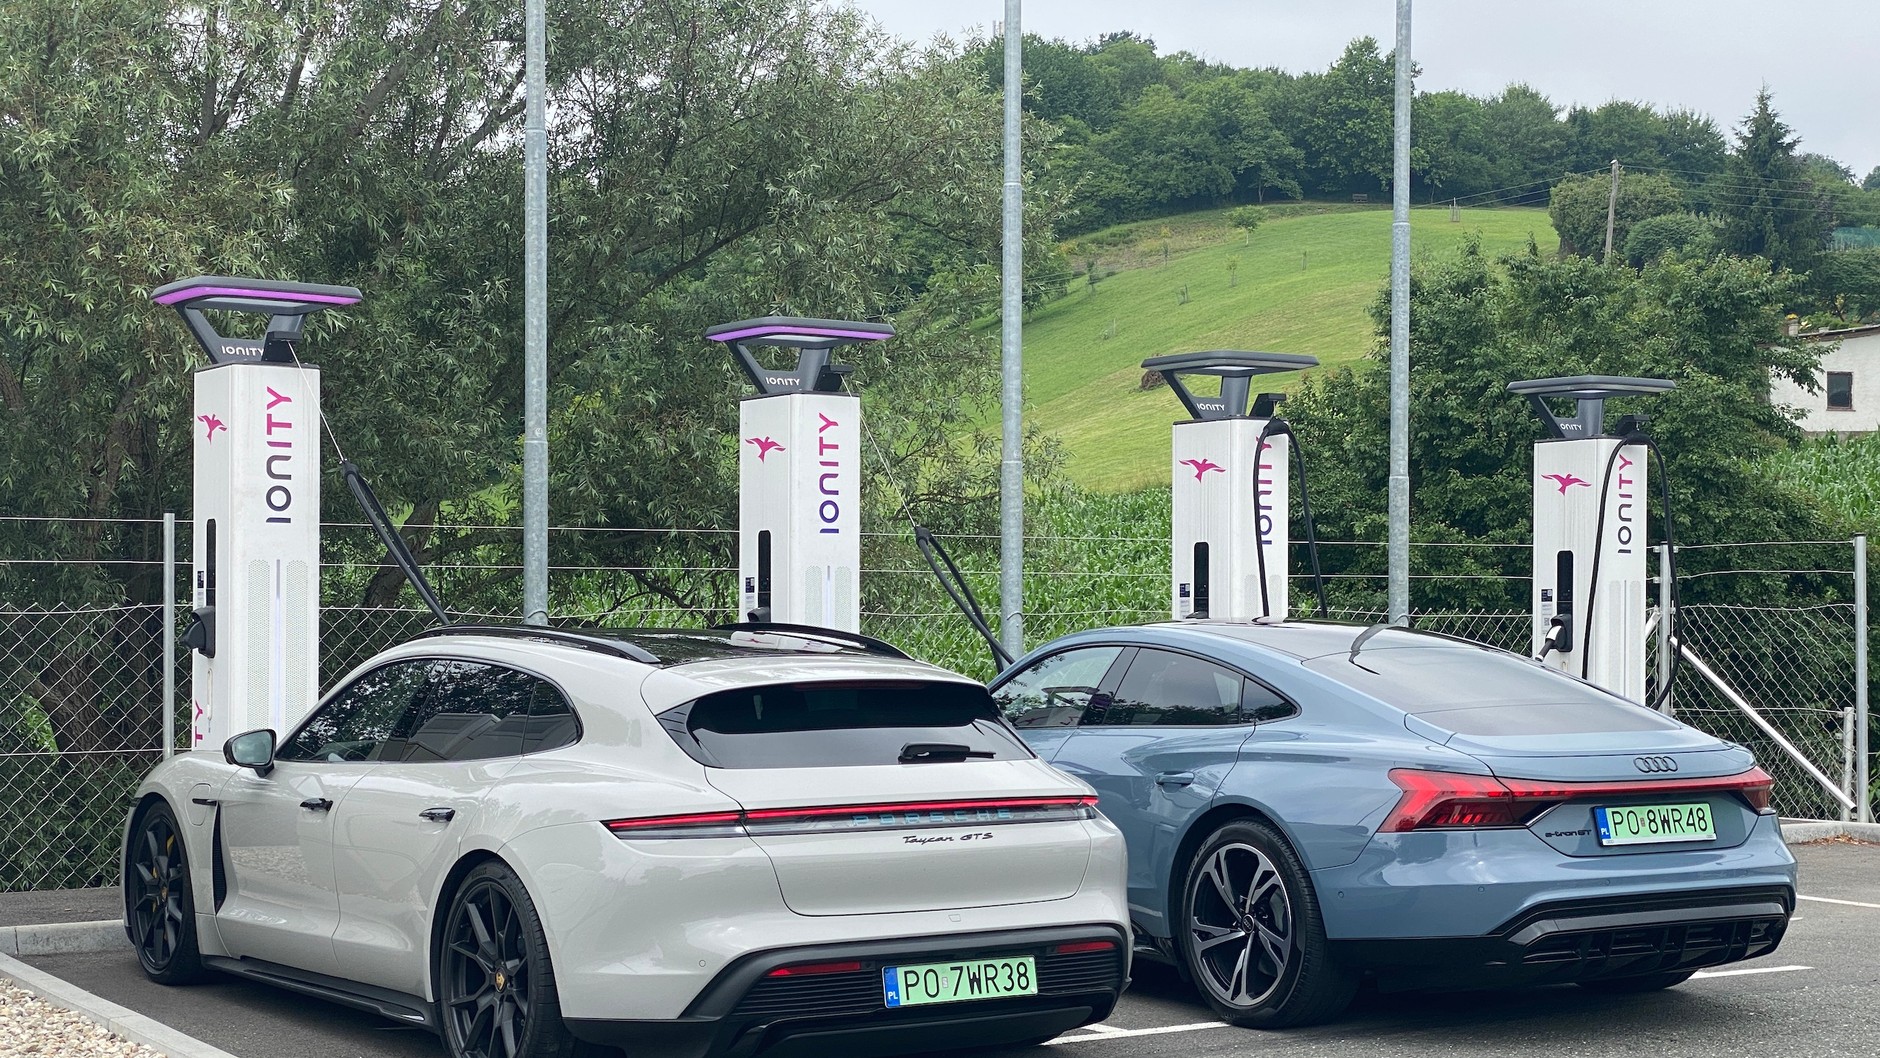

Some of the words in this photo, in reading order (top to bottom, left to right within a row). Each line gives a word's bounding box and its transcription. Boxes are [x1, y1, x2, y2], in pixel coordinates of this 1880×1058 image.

[221, 345, 264, 356] IONITY
[765, 377, 800, 386] IONITY
[1196, 403, 1225, 411] IONITY
[1560, 423, 1582, 431] ONITY
[265, 386, 292, 524] IONITY
[818, 412, 840, 534] IONITY
[1617, 454, 1633, 554] IONITY
[851, 808, 1013, 827] PORSCHE
[1611, 810, 1640, 836] PO
[1646, 807, 1708, 835] 8WR48
[1545, 830, 1577, 838] e-tron
[1600, 827, 1610, 836] PL
[902, 835, 954, 845] Taycan
[960, 832, 994, 841] GTS
[903, 968, 940, 1000] PO
[949, 961, 1030, 997] 7WR38
[887, 991, 898, 1000] PL
